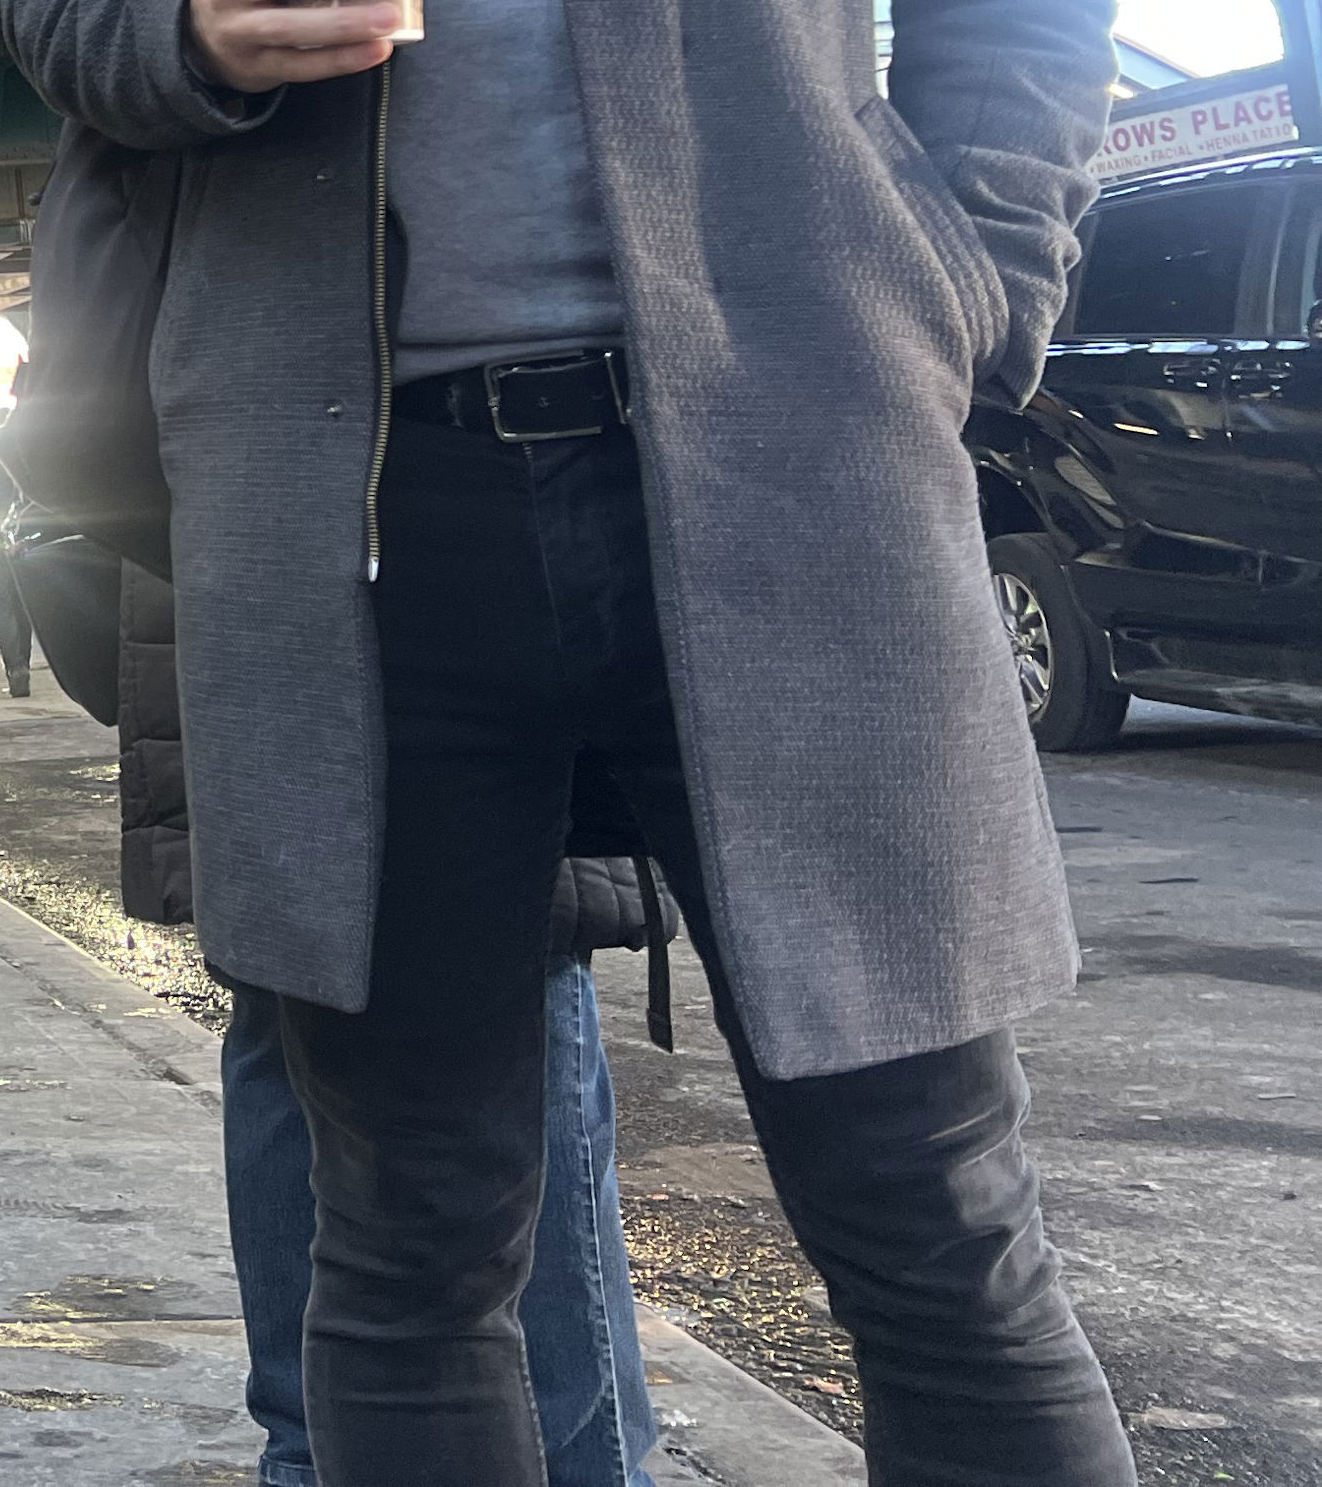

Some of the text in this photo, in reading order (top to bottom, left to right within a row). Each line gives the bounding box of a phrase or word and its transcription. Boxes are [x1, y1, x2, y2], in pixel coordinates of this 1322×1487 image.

[1191, 90, 1292, 135] PLACE
[1096, 155, 1141, 174] WAXING
[1150, 145, 1193, 162] FACIAL
[1206, 131, 1250, 151] HENNA
